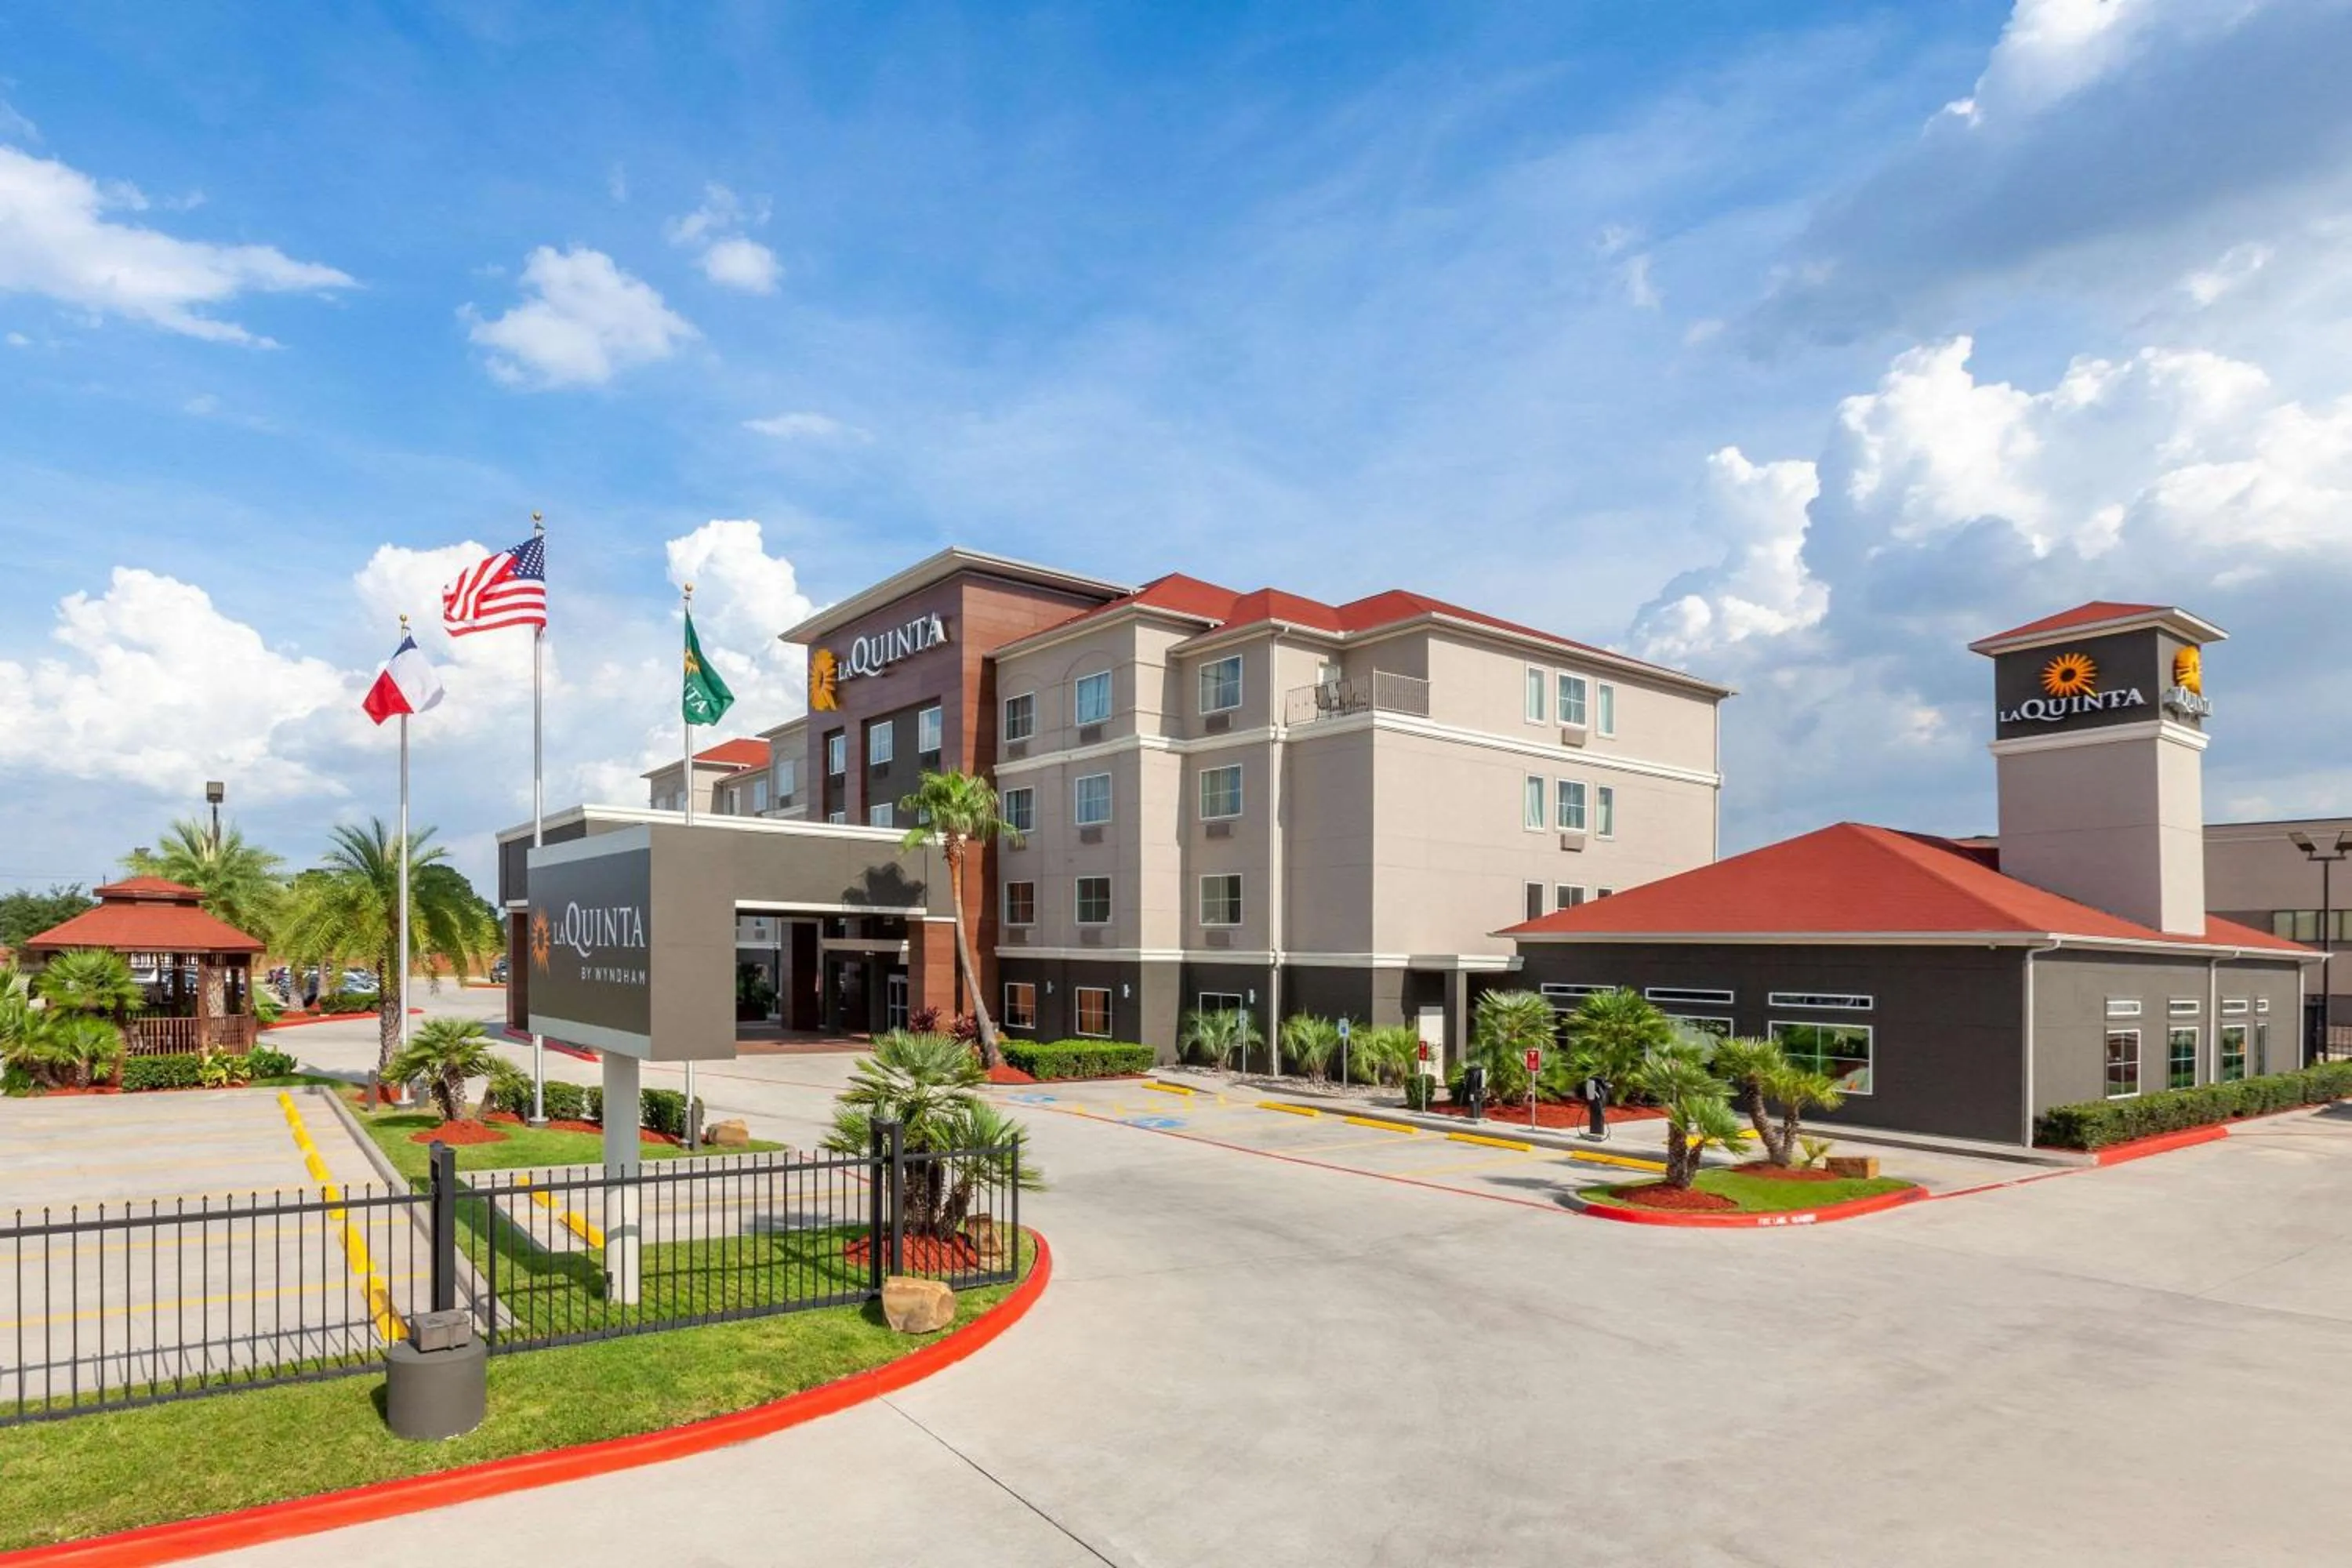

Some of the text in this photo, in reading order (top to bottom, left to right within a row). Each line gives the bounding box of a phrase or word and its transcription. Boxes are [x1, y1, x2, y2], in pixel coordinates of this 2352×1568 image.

[837, 612, 947, 681] LA QUINTA
[2000, 688, 2147, 722] LA QUINTA
[553, 902, 645, 958] LA QUINTA
[581, 966, 646, 985] BY WYNDHAM
